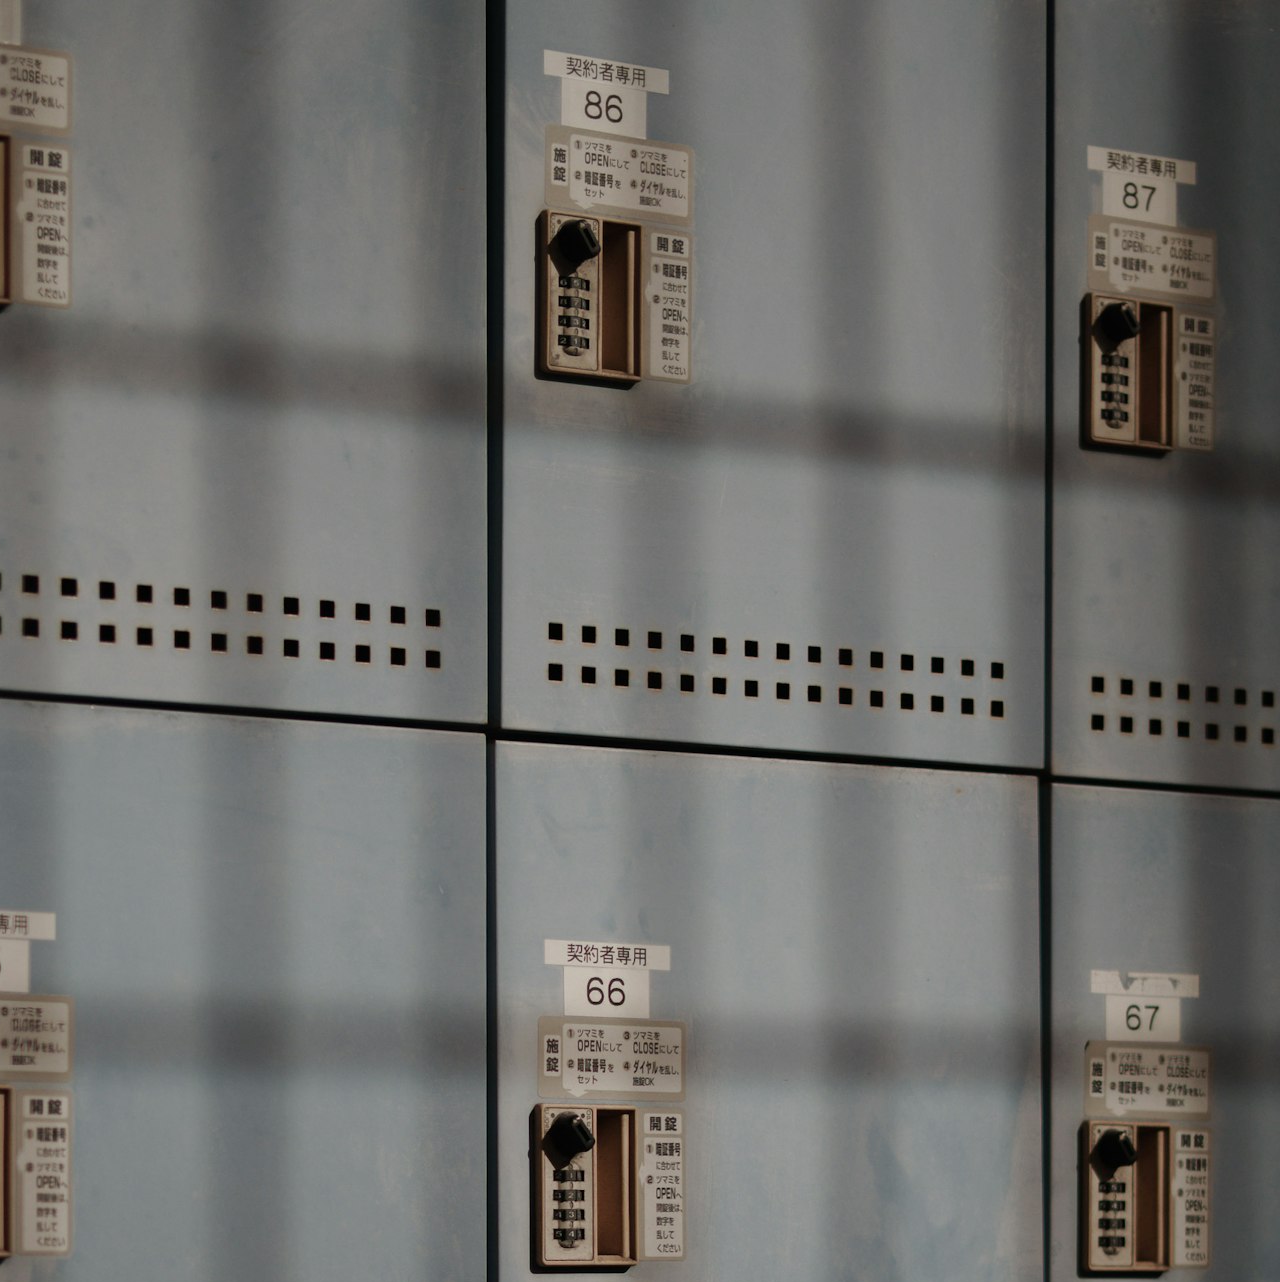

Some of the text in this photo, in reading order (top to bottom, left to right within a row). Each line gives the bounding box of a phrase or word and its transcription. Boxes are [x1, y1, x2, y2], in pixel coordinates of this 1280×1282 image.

[567, 57, 646, 87] 契約者専用
[585, 91, 623, 123] 86
[585, 141, 611, 154] ツマミを
[585, 152, 629, 169] OPENにして
[640, 150, 667, 163] ツマミを
[554, 147, 566, 183] 施錠
[640, 161, 686, 179] CLOSEにして
[1107, 152, 1176, 178] 契約者専用
[585, 171, 621, 189] 暗証番号を
[584, 188, 604, 199] セット
[1123, 182, 1155, 212] 87
[657, 237, 684, 254] 開錠
[663, 296, 686, 308] ツマミを
[662, 308, 688, 323] OPENへ
[662, 364, 686, 376] ください
[567, 943, 647, 967] 契約者専用
[587, 977, 626, 1006] 66
[1126, 1005, 1159, 1030] 67
[577, 1029, 604, 1039] ツマミを
[633, 1031, 660, 1040] ツマミを
[577, 1039, 622, 1052] OPENにして
[633, 1042, 679, 1054] CLOSEにして
[547, 1039, 559, 1073] 施錠
[577, 1059, 614, 1073] 暗証番号を
[577, 1075, 597, 1085] セット
[650, 1117, 677, 1131] 開錠
[656, 1142, 680, 1156] 暗証番号
[656, 1176, 679, 1184] ツマミを
[656, 1187, 682, 1199] OPENへ
[657, 1230, 675, 1240] 乱して
[657, 1244, 681, 1253] ください
